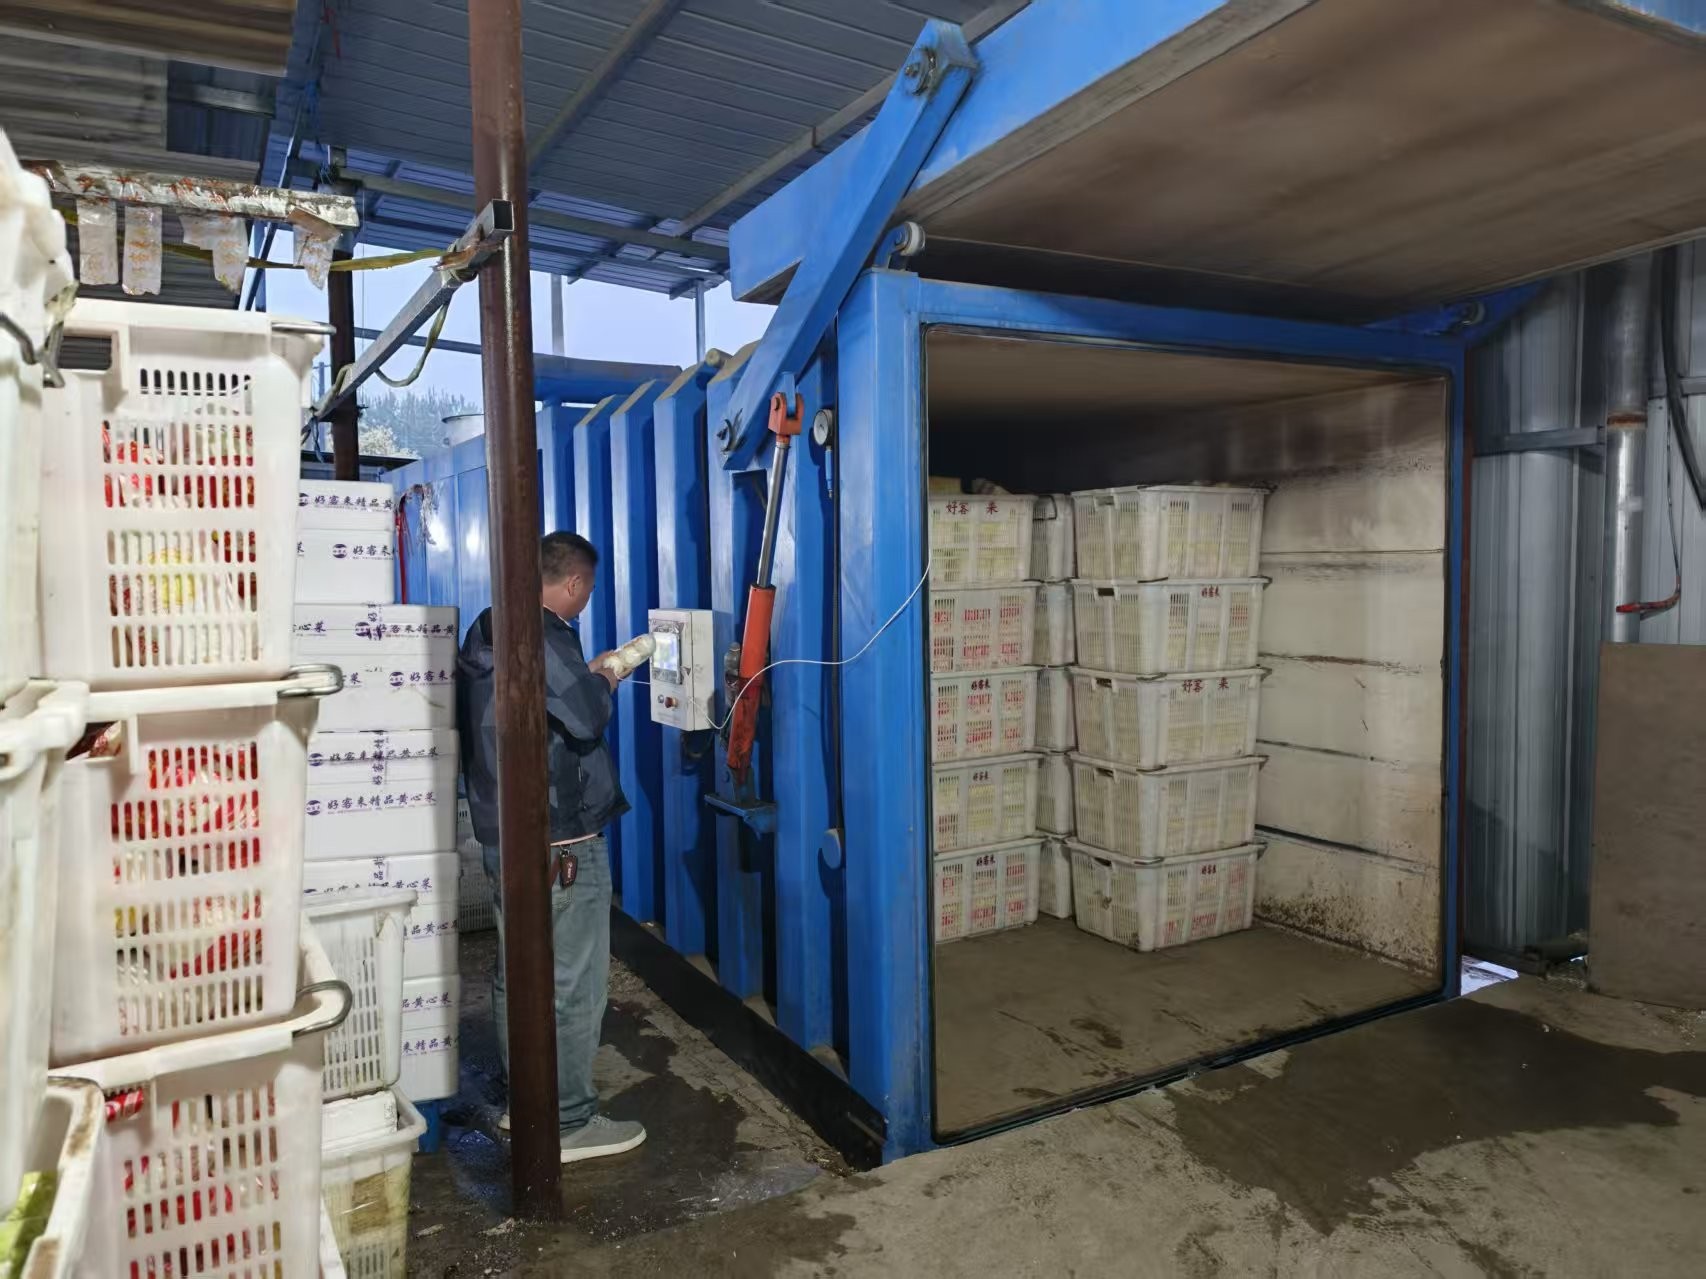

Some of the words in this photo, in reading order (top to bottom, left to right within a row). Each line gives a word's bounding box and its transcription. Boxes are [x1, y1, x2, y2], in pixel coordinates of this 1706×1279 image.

[353, 544, 394, 557] 好客来
[327, 791, 438, 810] 好客来精品黄心菜
[403, 920, 459, 936] 品黄心菜
